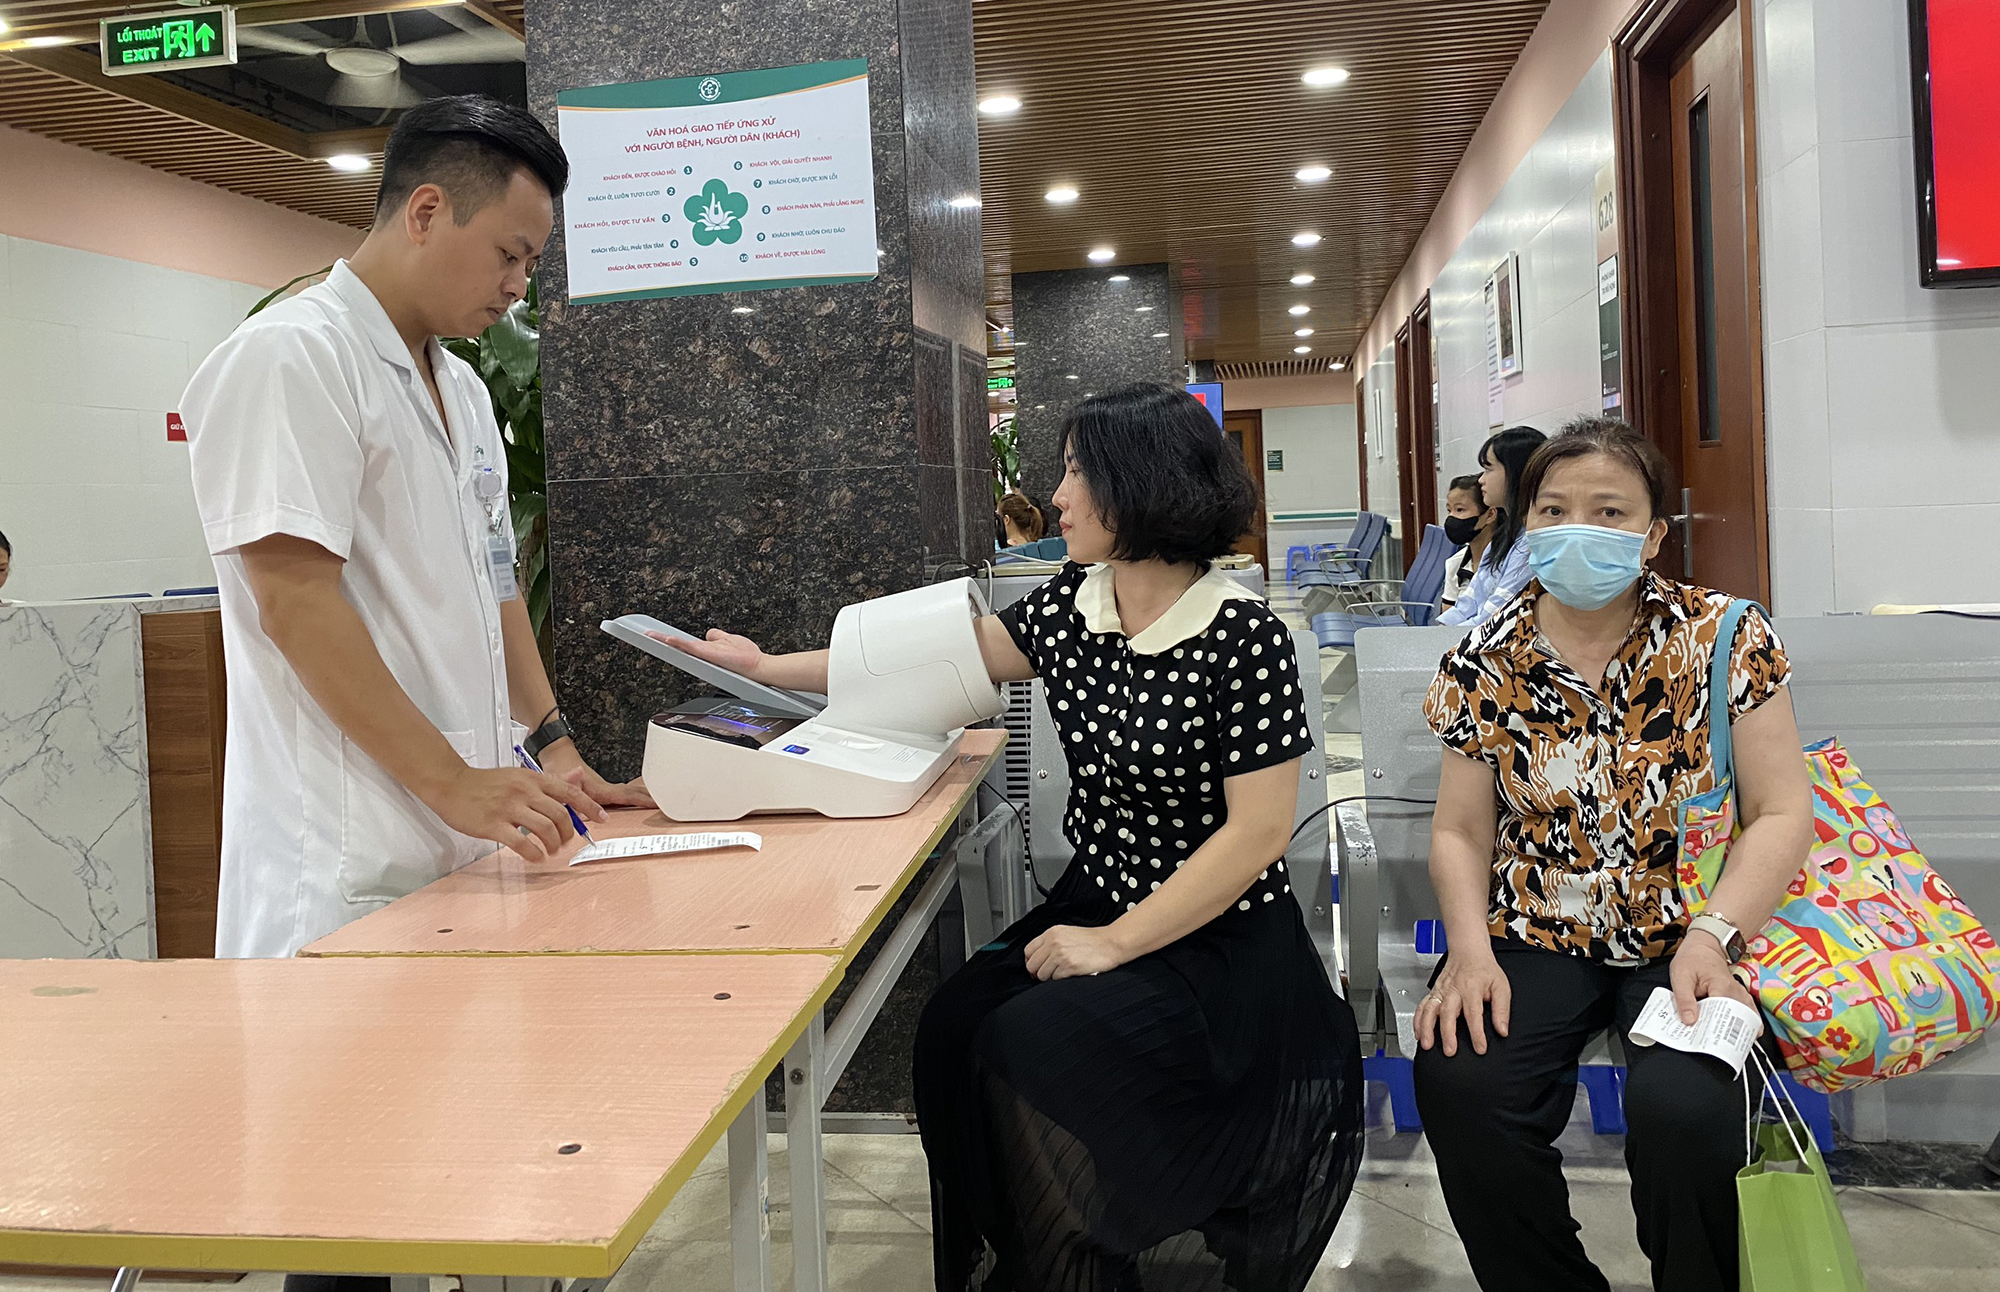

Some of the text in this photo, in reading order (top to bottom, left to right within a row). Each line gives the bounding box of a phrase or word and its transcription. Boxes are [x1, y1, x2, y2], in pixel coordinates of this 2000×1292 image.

[117, 26, 162, 42] LỐI THOÁT
[123, 47, 159, 63] EXIT
[647, 115, 776, 137] VĂN HOÁ GIAO TIẾP ỨNG XỬ
[625, 129, 800, 153] VỚI NGƯỜI BỆNH, NGƯỜI DÂN (KHÁCH)
[794, 156, 811, 164] QUYẾT
[1598, 191, 1614, 232] 628
[625, 263, 636, 271] CẦN,
[1658, 1009, 1668, 1019] 55
